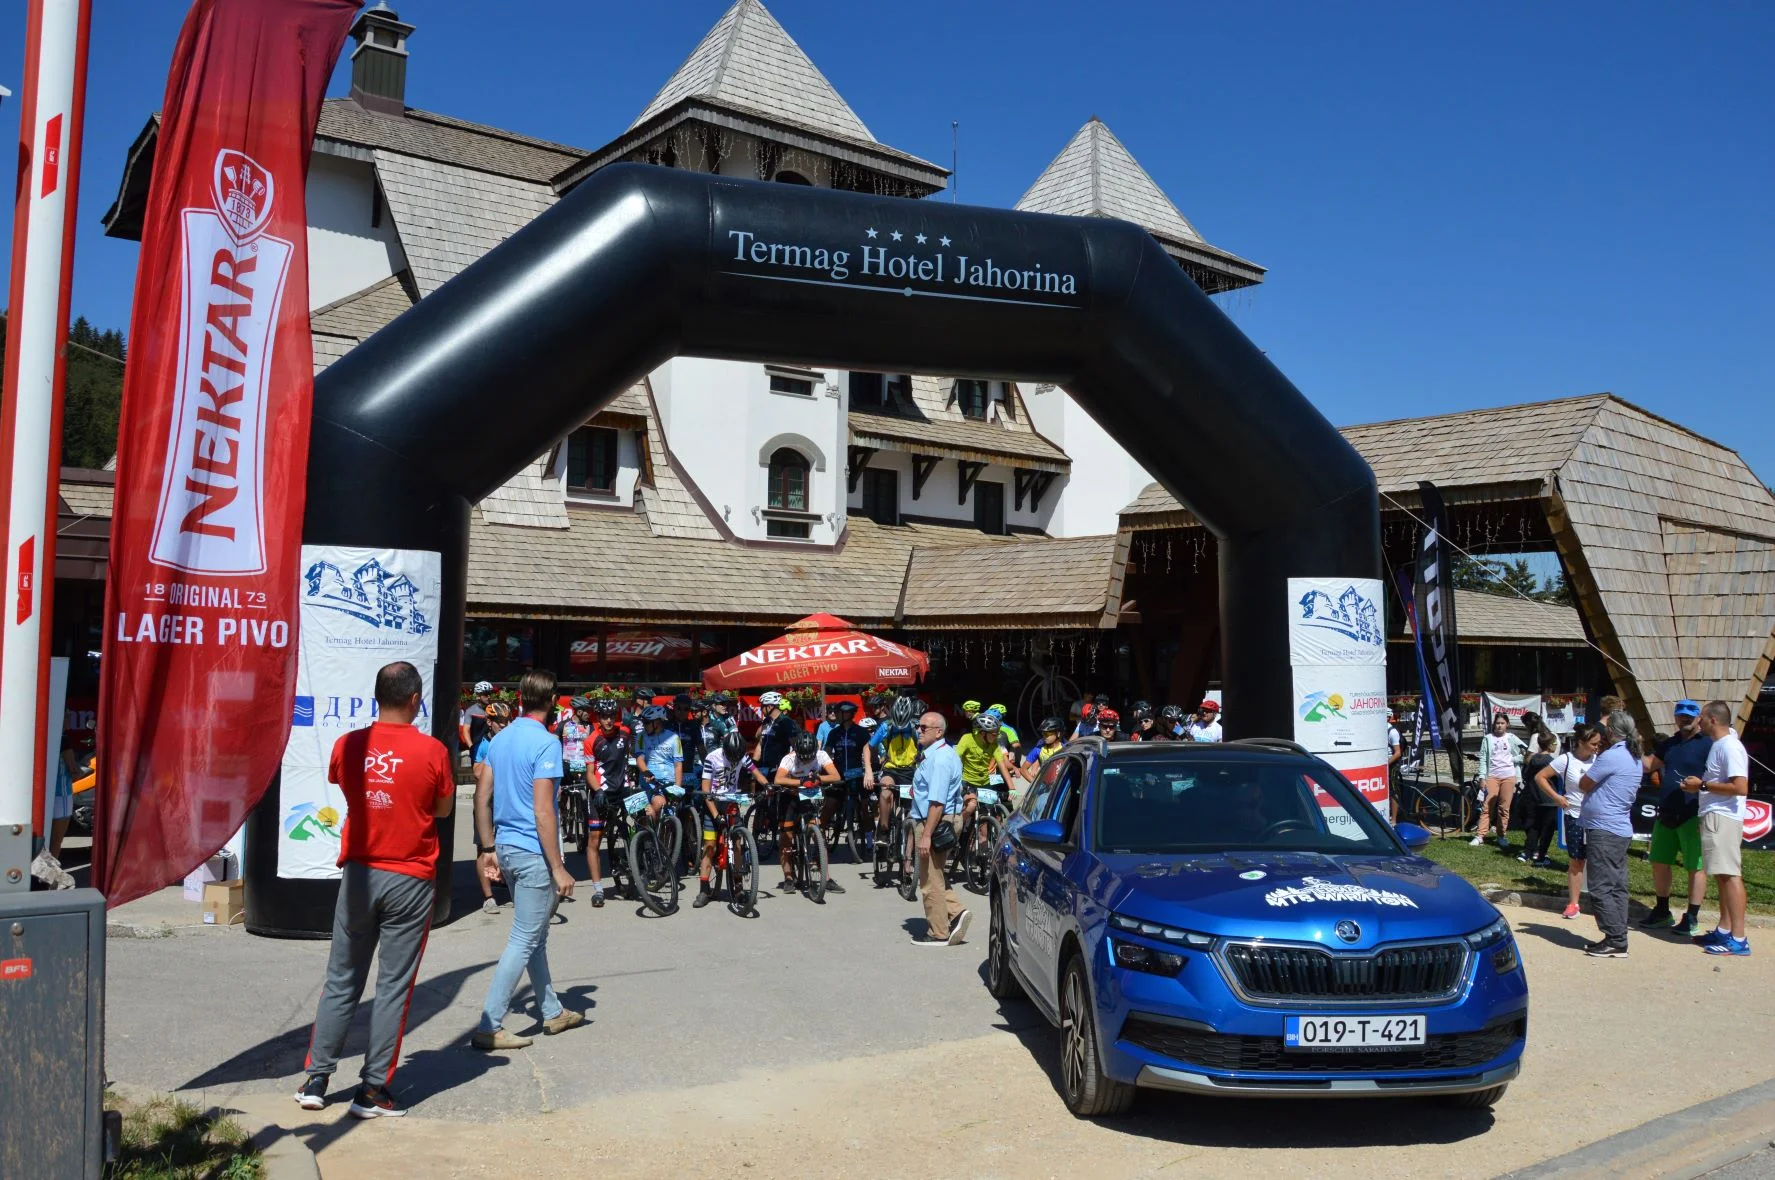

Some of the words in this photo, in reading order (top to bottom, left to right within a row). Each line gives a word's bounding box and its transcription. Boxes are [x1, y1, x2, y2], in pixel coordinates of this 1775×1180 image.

[231, 199, 251, 219] 1873
[728, 230, 850, 280] Termag
[860, 245, 944, 282] Hotel
[953, 256, 1077, 295] Jahorina
[180, 248, 257, 542] NEKTAR
[144, 583, 165, 595] 18
[169, 582, 242, 609] ORIGINAL
[246, 591, 267, 603] 73
[117, 612, 204, 645] LAGER
[218, 618, 289, 648] PIVO
[354, 637, 375, 645] Hotel
[739, 639, 872, 667] NEKTAR
[776, 665, 810, 683] LAGER
[813, 663, 839, 676] PIVO
[878, 668, 909, 677] NEKTAR
[1303, 1019, 1421, 1043] 019-T-421
